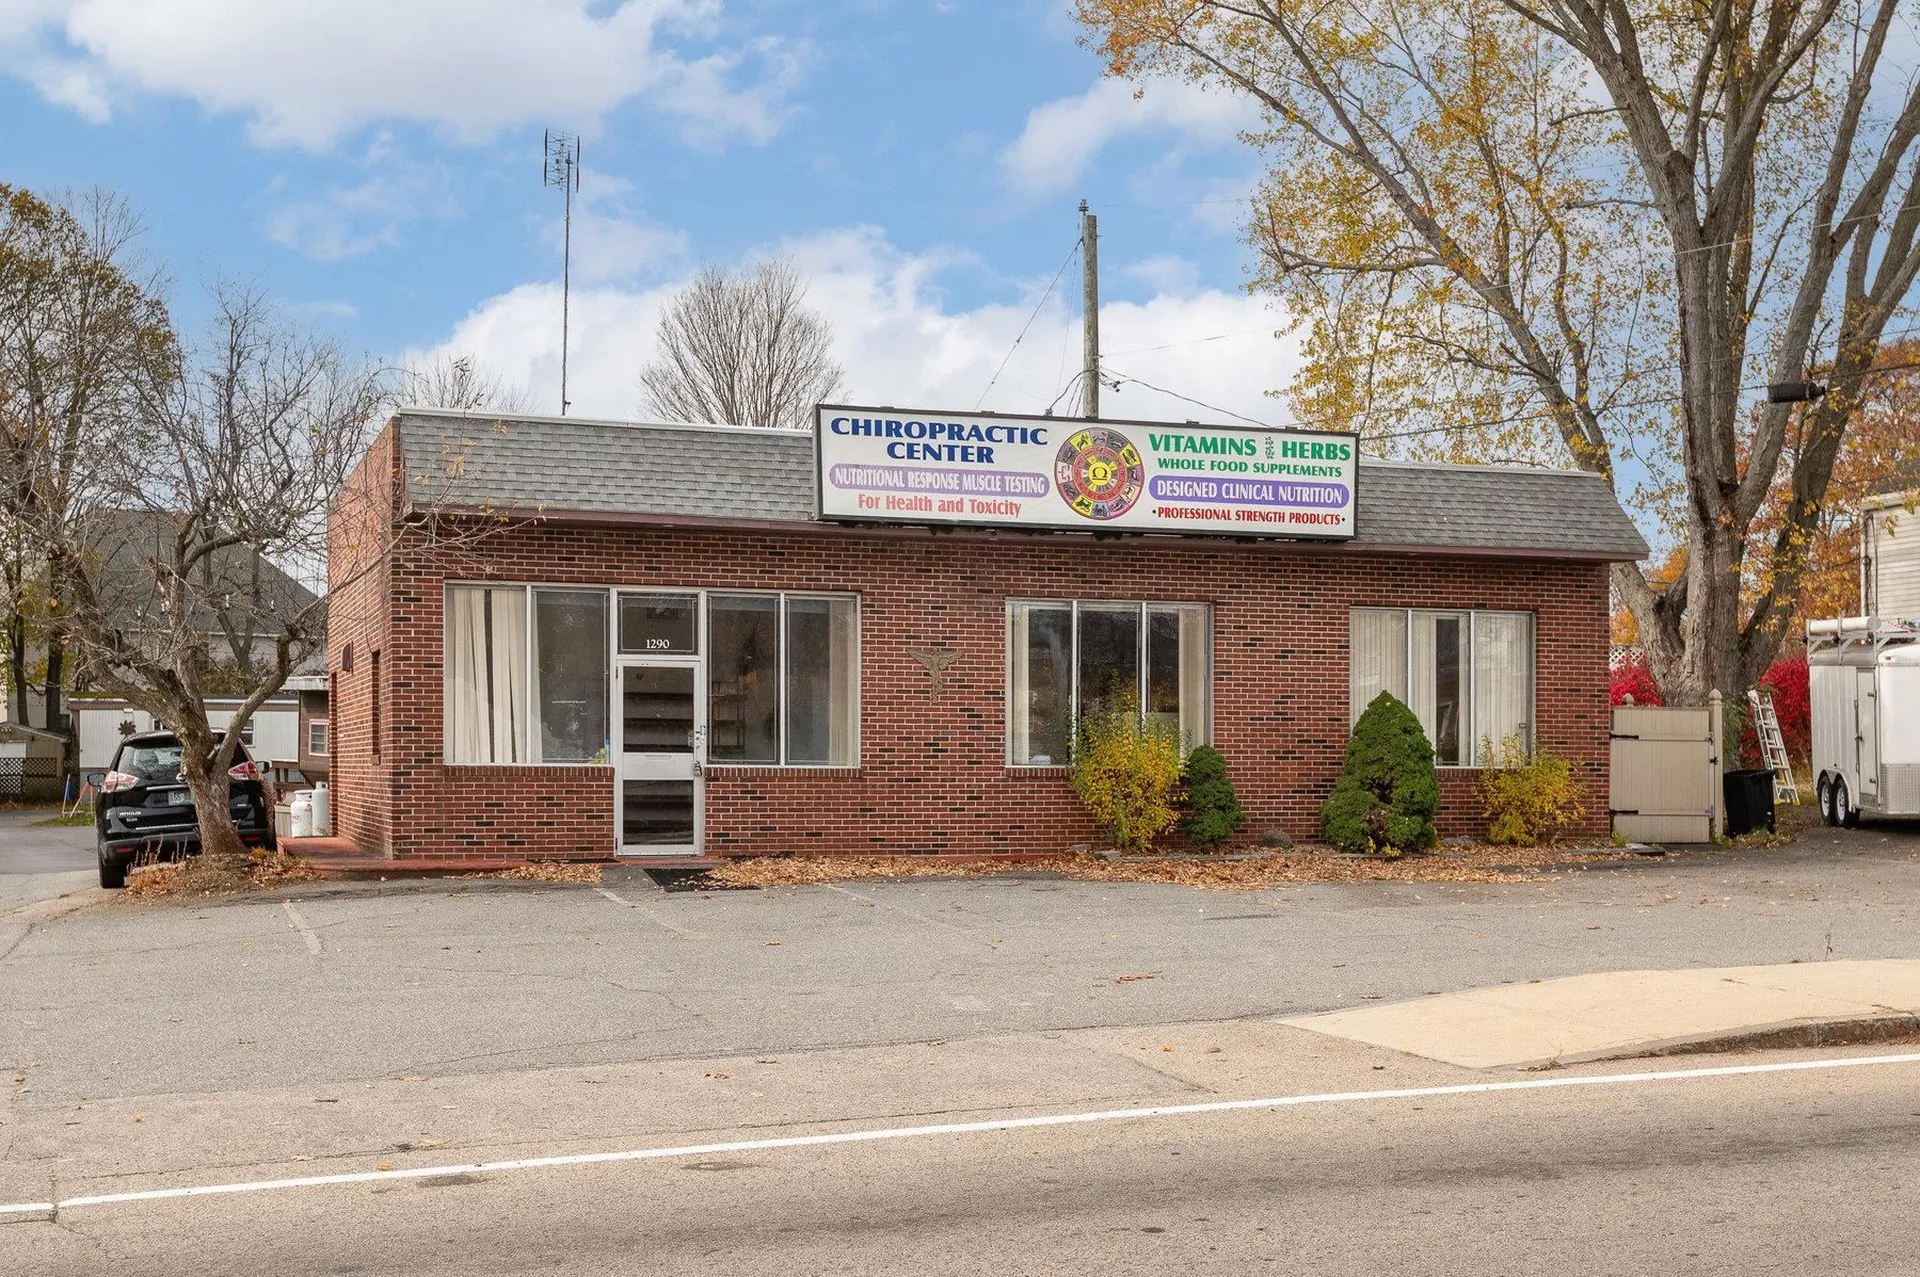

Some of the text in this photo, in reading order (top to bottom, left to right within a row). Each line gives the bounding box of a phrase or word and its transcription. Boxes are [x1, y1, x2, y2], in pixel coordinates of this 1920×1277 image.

[831, 417, 1048, 446] CHIROPRACTIC
[886, 441, 995, 464] CENTER
[1148, 433, 1351, 461] VITAMINS HERBS
[1158, 458, 1343, 478] WHOLE FOOD SUPPLEMENTS
[835, 467, 1045, 494] NUTRITIONAL RESPONSE MUSCLE TESTING
[1157, 480, 1343, 504] DESIGNED CLINICAL NUTRITION
[858, 493, 1021, 518] For Health and Toxicity
[1158, 506, 1341, 525] PROFESSIONAL STRENGTH PRODUCTS
[645, 639, 670, 649] 1290
